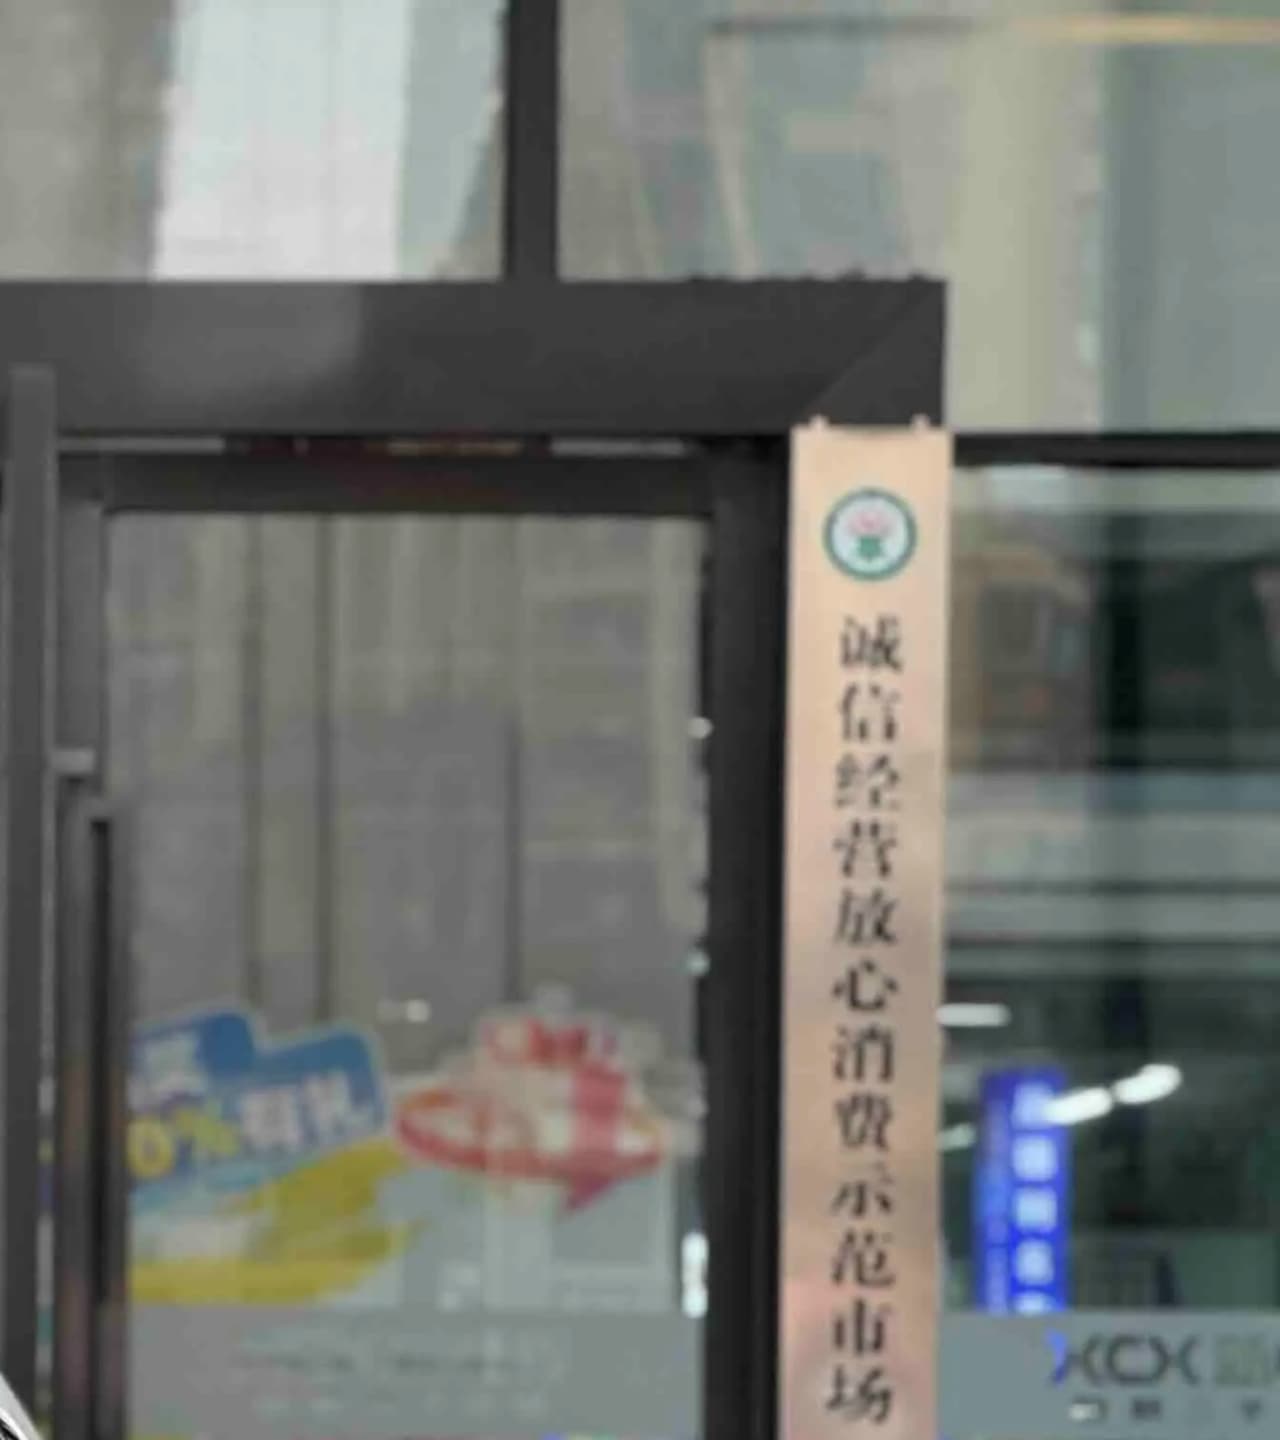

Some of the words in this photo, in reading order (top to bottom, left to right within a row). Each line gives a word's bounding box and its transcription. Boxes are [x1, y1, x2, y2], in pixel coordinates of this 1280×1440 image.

[824, 616, 906, 1424] 诚信经营放心消费示范市场
